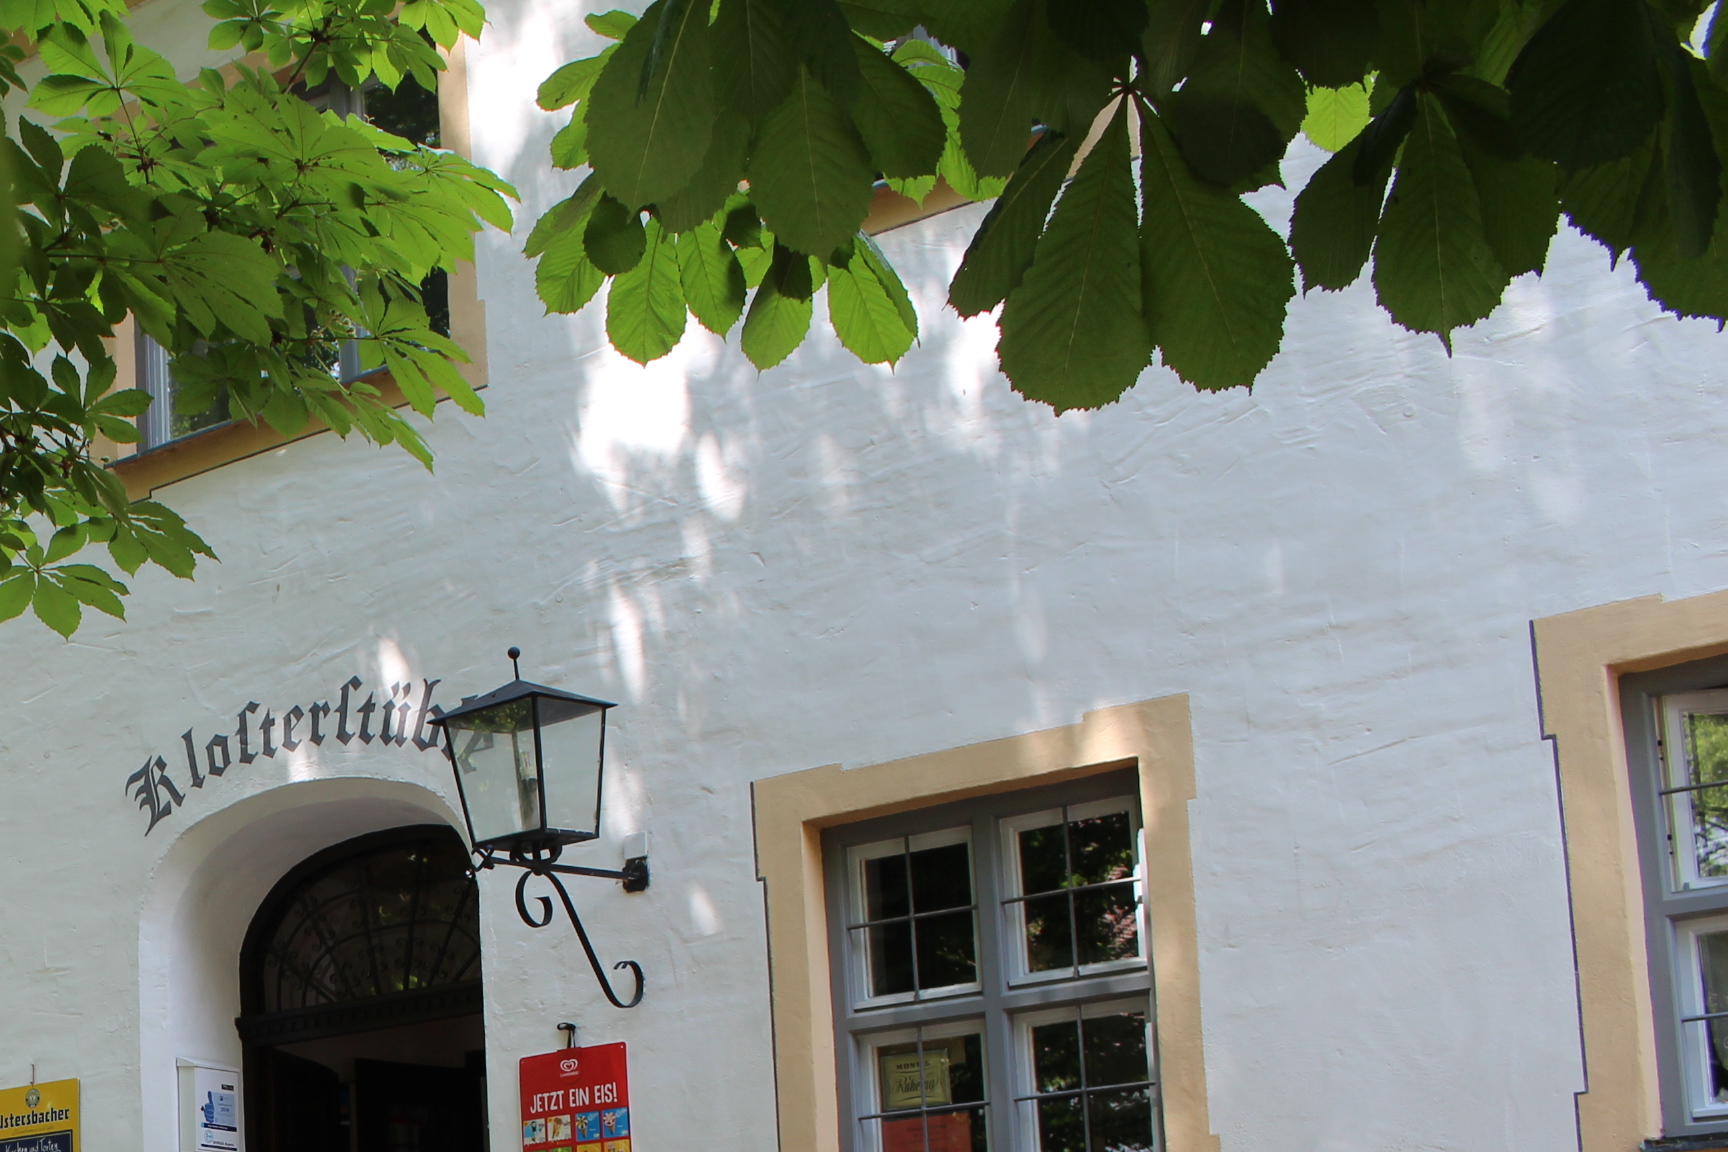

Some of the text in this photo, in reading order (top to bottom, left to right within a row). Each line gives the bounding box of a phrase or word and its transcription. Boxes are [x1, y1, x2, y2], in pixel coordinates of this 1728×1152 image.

[530, 1082, 618, 1114] JETZT EIN EIS!
[29, 1140, 38, 1152] und
[39, 1138, 58, 1152] Torten
